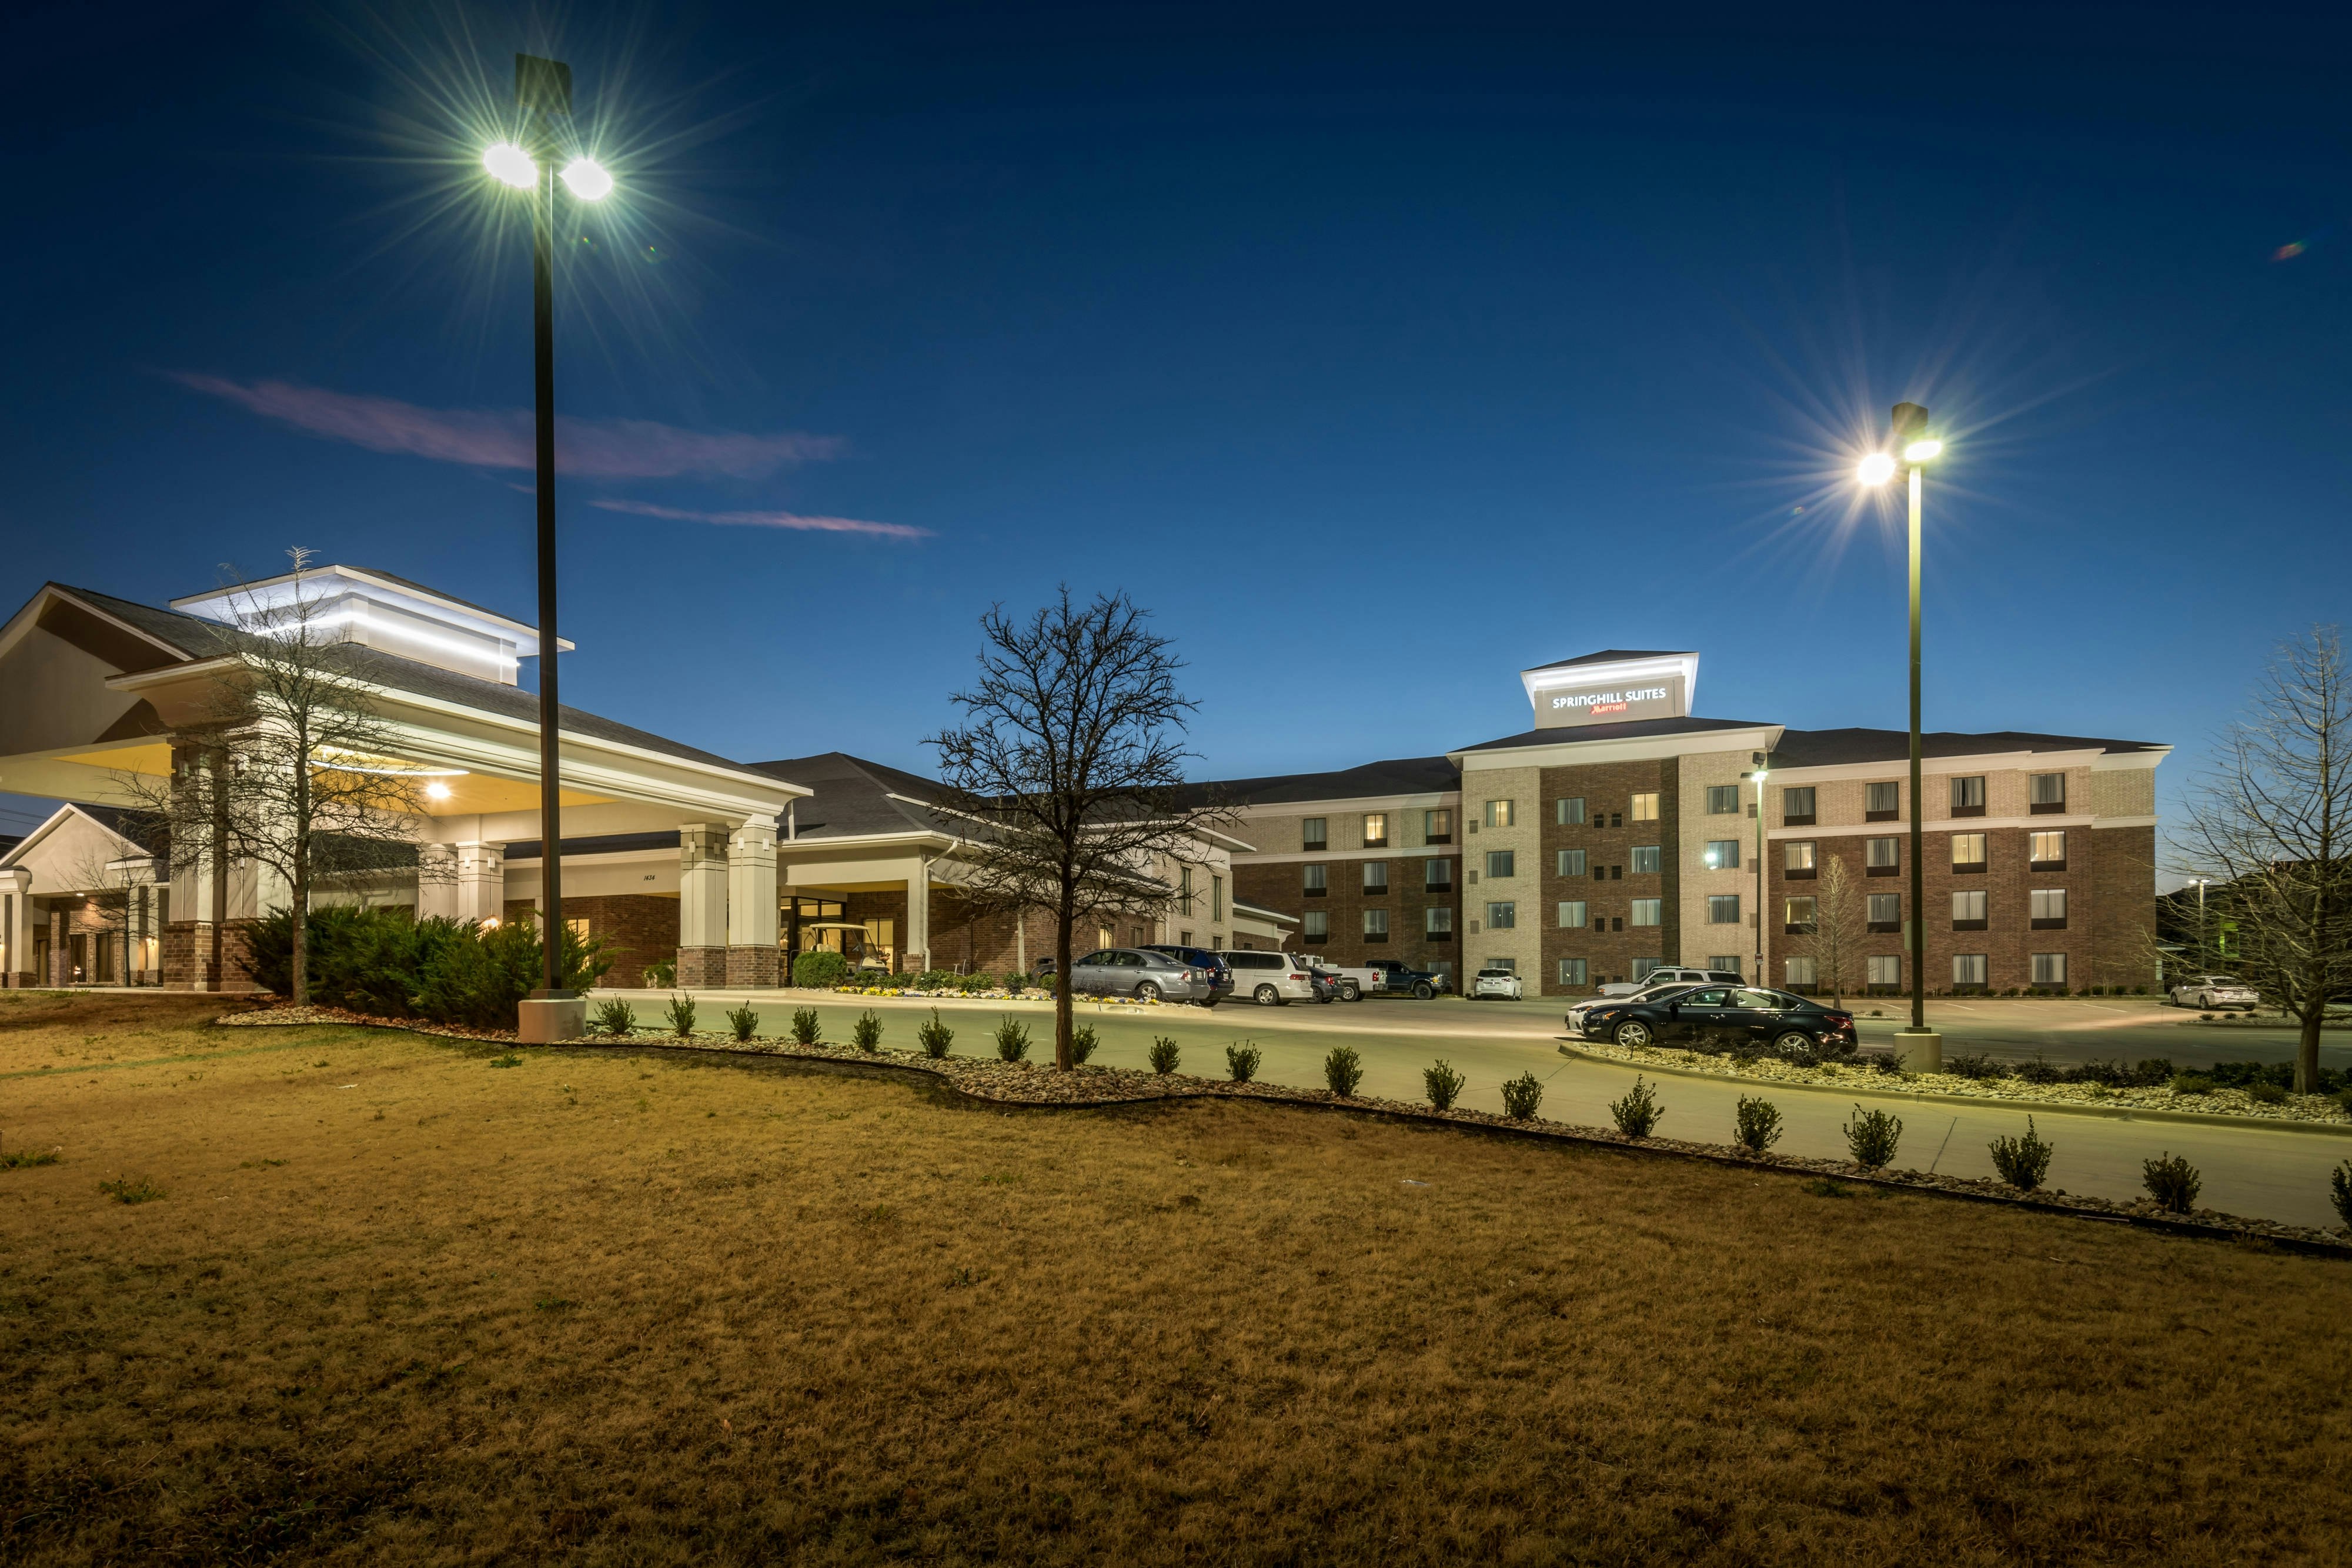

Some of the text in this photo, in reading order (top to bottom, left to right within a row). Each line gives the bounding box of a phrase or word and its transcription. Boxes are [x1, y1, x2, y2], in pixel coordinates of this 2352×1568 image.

[1552, 688, 1666, 708] SPRINGHILL SUITES
[1590, 703, 1626, 714] Marriott
